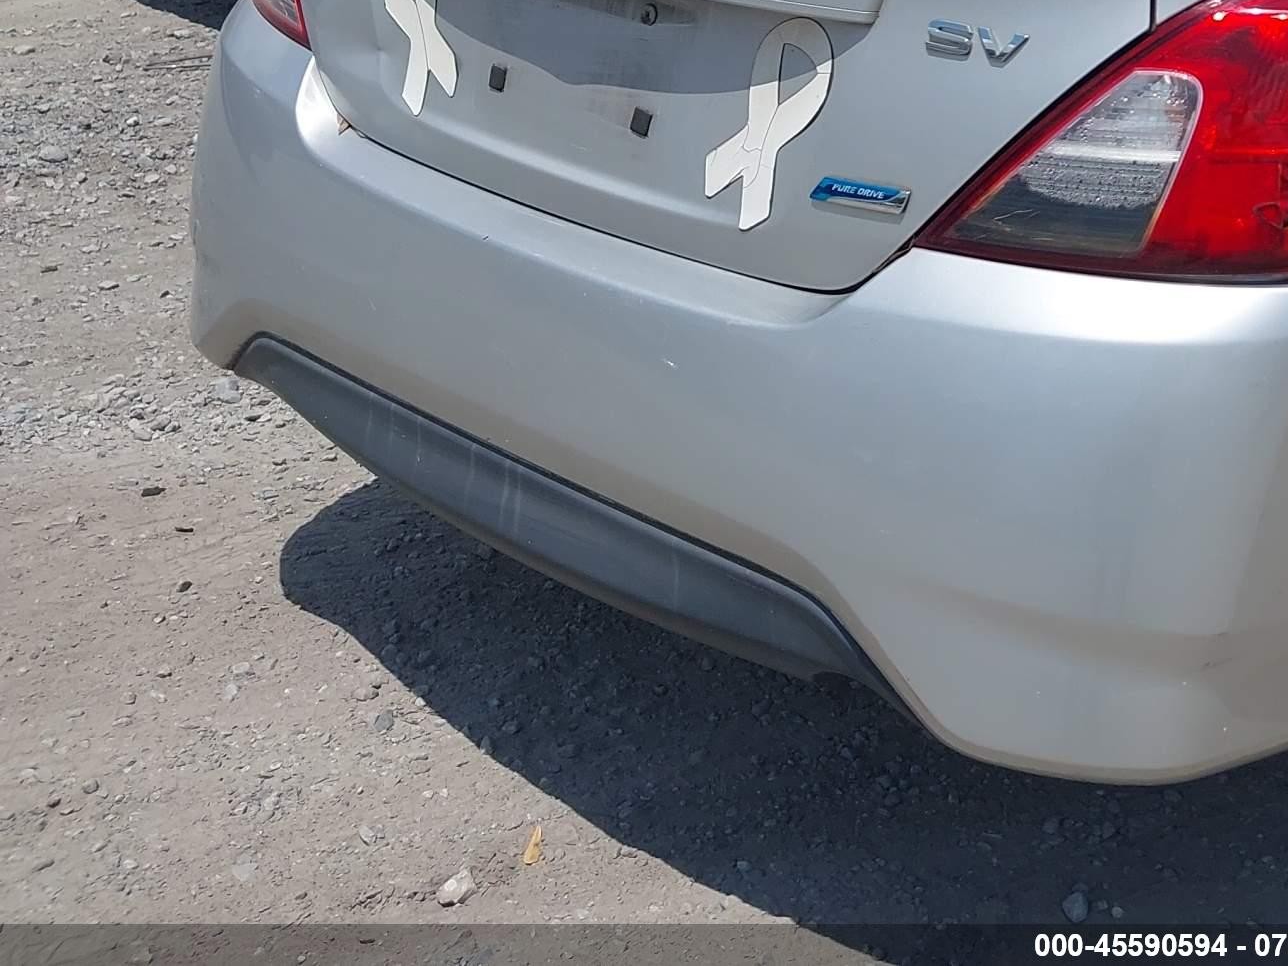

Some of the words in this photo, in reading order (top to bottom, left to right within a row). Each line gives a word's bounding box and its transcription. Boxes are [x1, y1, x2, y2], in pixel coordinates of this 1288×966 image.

[925, 18, 1030, 68] SV
[831, 183, 858, 194] PURE
[857, 187, 885, 199] DRIVE
